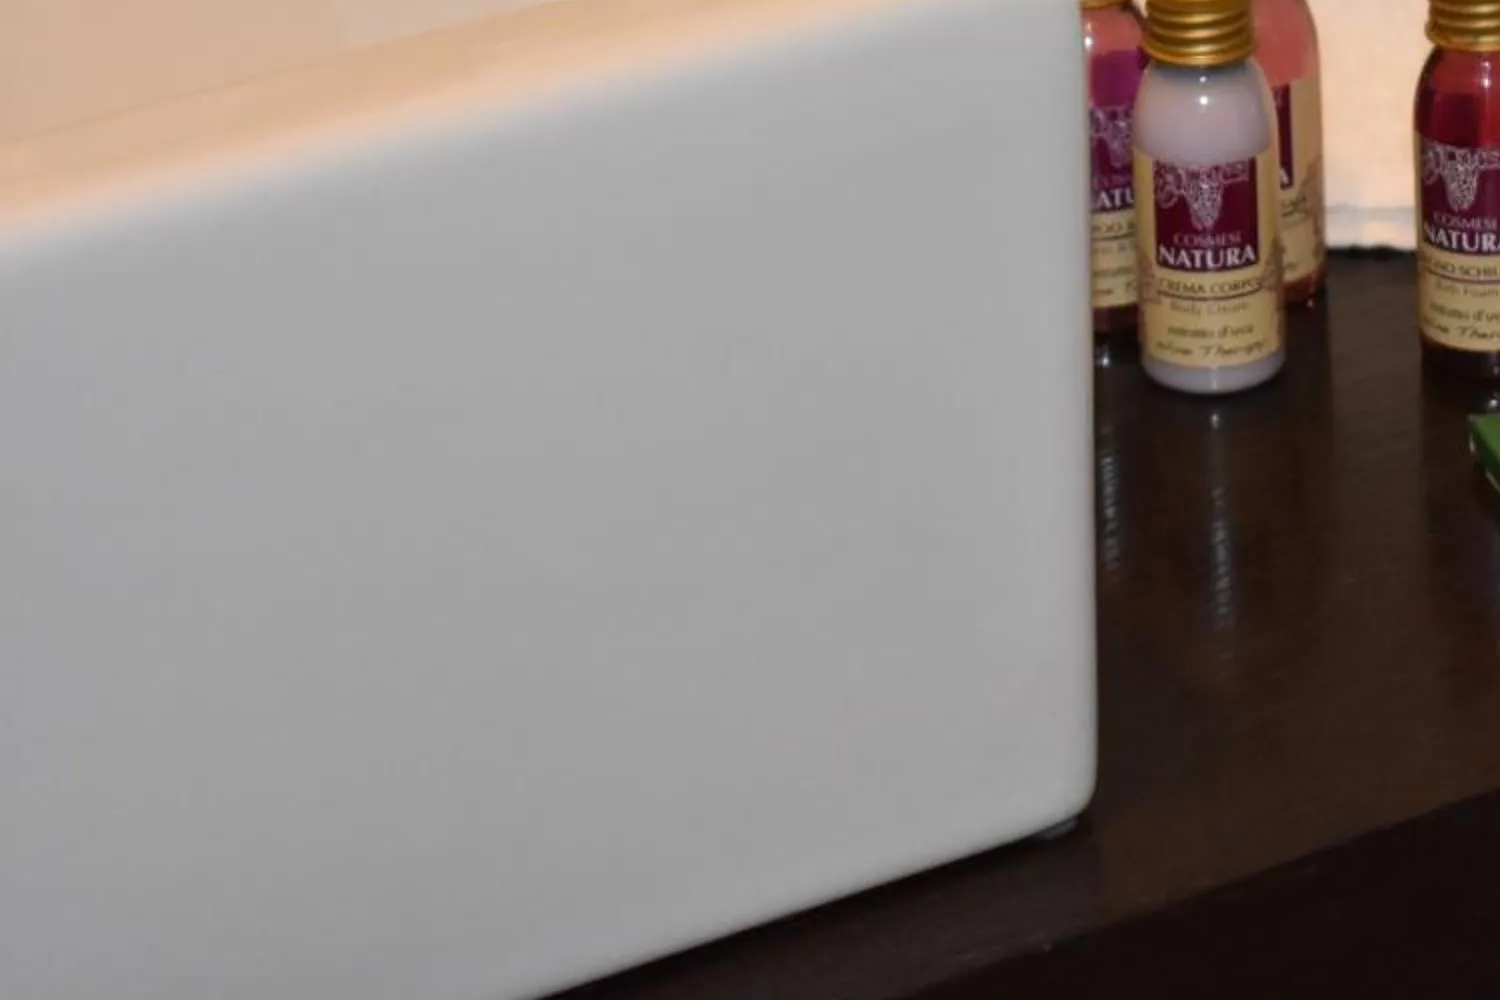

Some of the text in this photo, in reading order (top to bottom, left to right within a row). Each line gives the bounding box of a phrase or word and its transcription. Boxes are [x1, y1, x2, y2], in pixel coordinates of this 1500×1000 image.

[1097, 186, 1134, 208] ATU
[1433, 211, 1498, 231] COSMESI
[1172, 231, 1242, 247] COSMESI
[1159, 243, 1256, 269] NATURA
